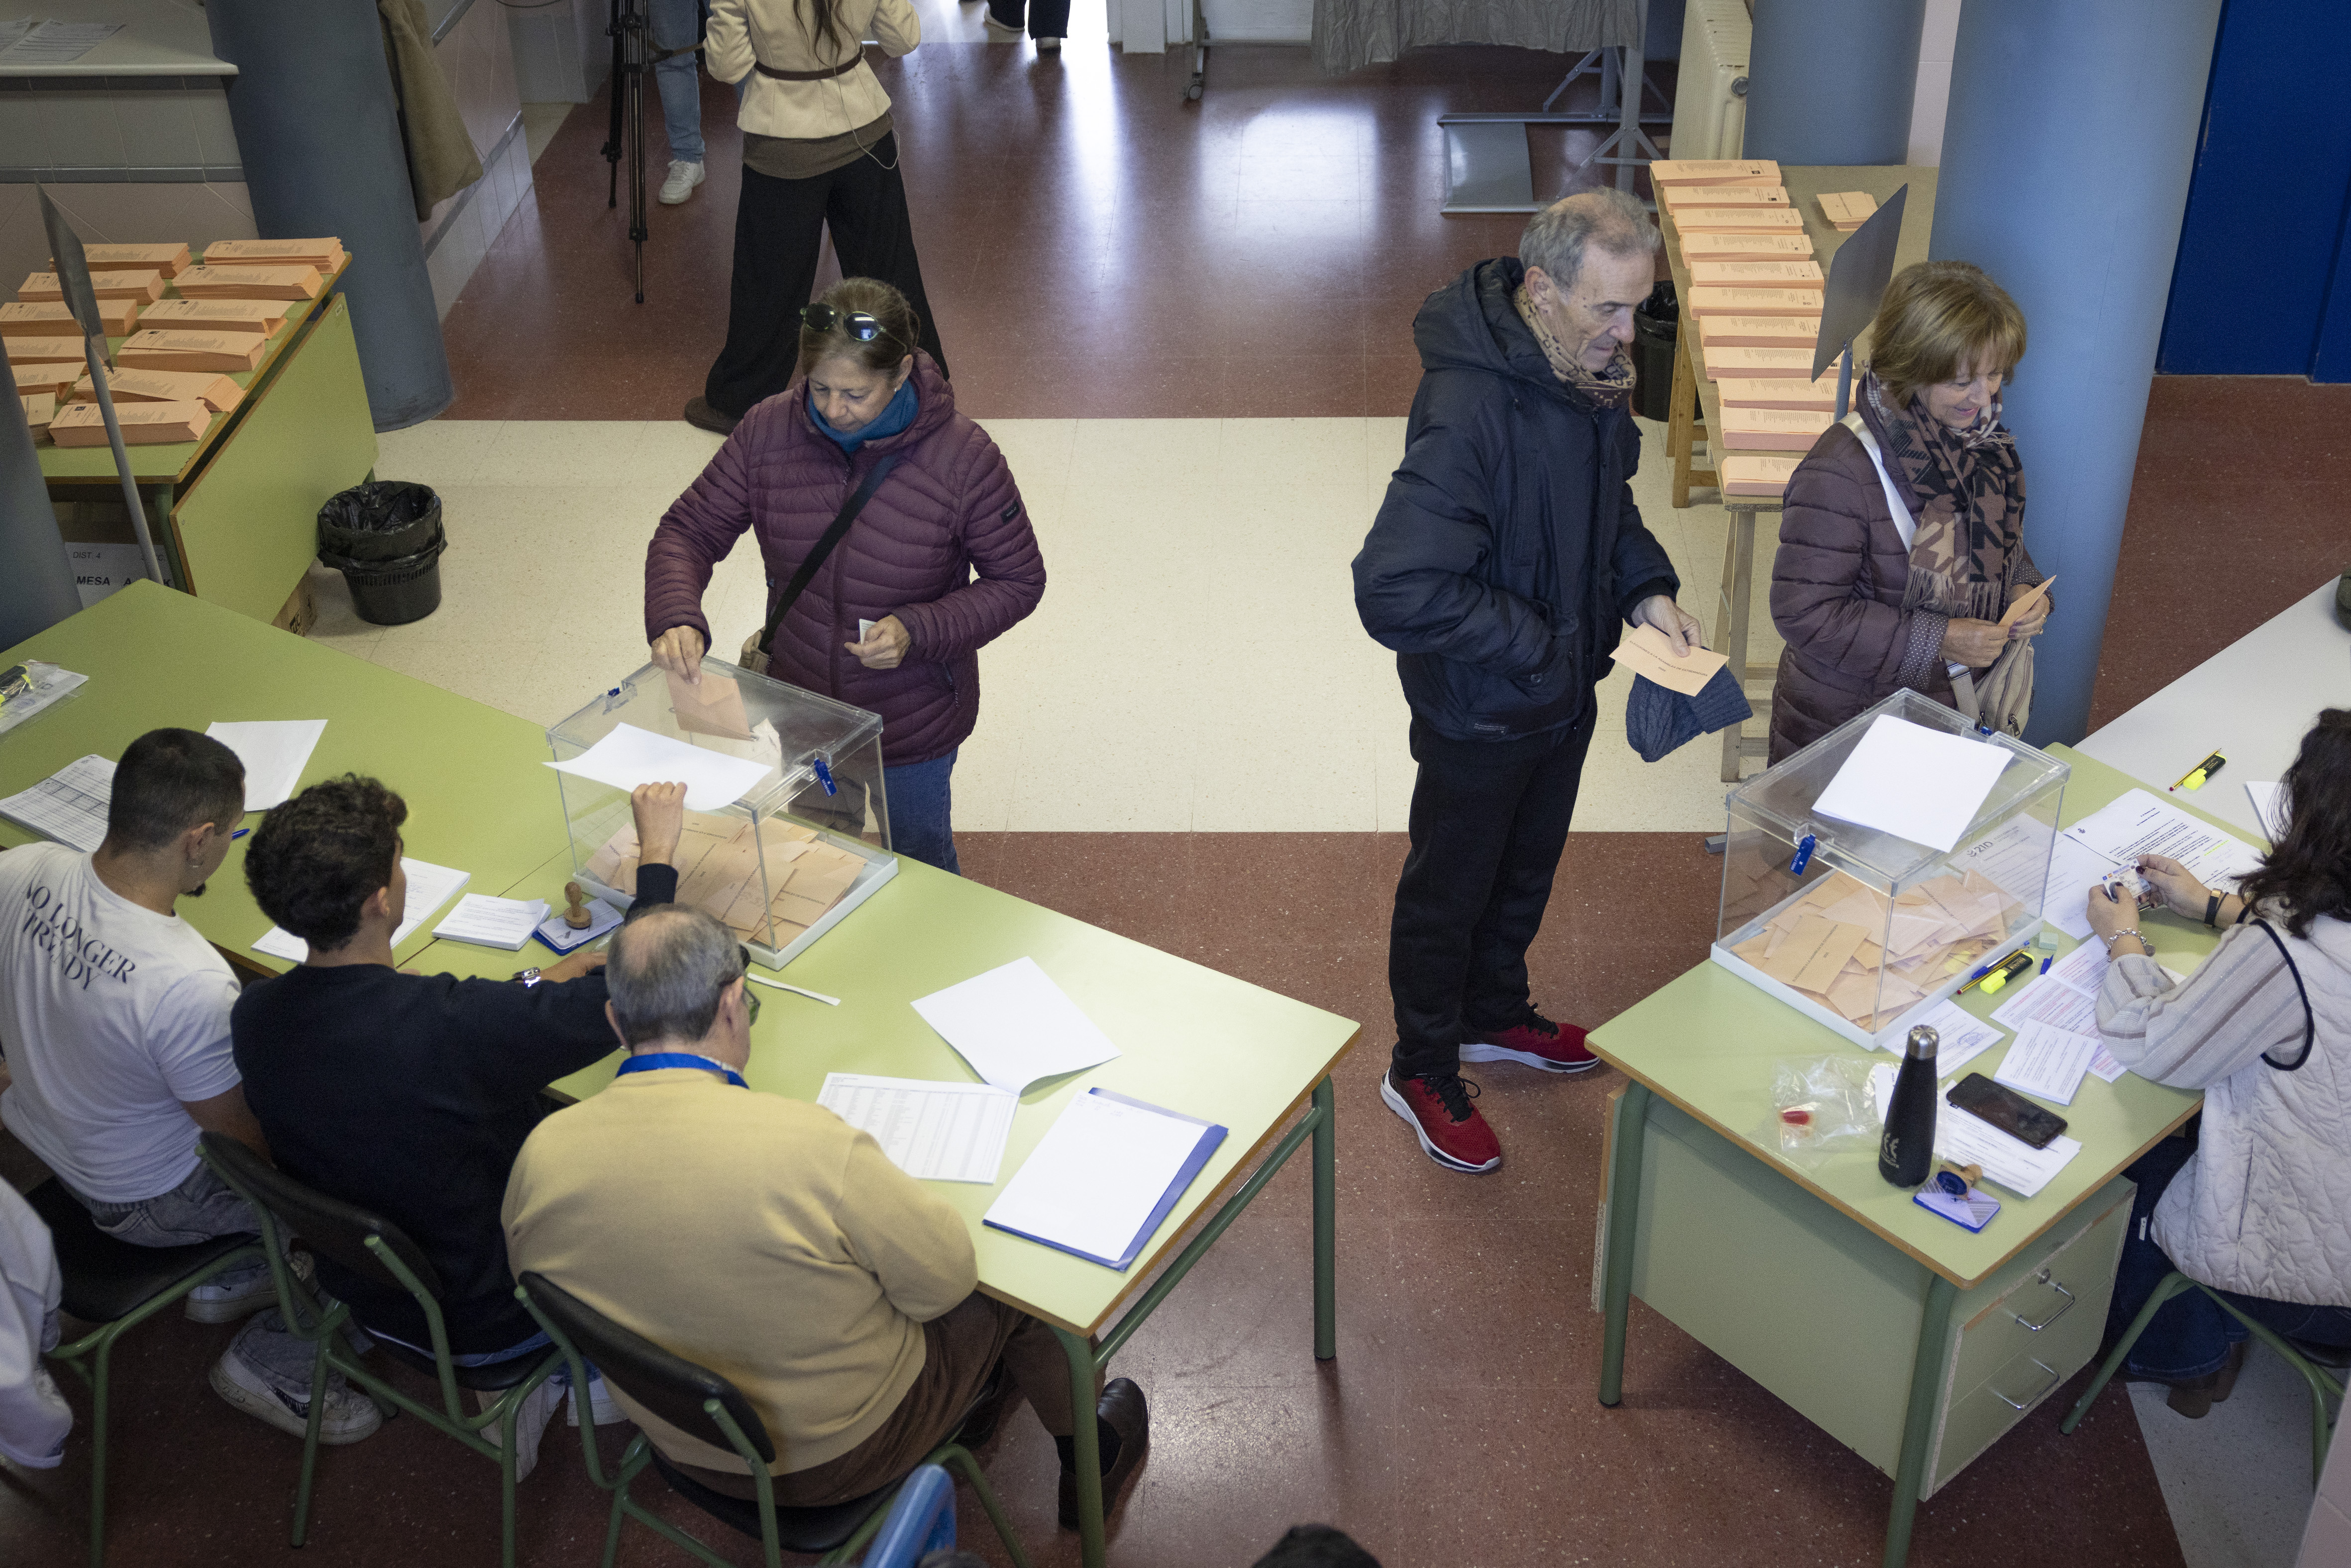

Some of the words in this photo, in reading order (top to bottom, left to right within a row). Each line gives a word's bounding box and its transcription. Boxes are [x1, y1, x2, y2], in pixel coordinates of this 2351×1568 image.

[77, 576, 110, 586] MESA
[1629, 640, 1650, 654] ELECCIONES
[49, 903, 136, 984] LONGER
